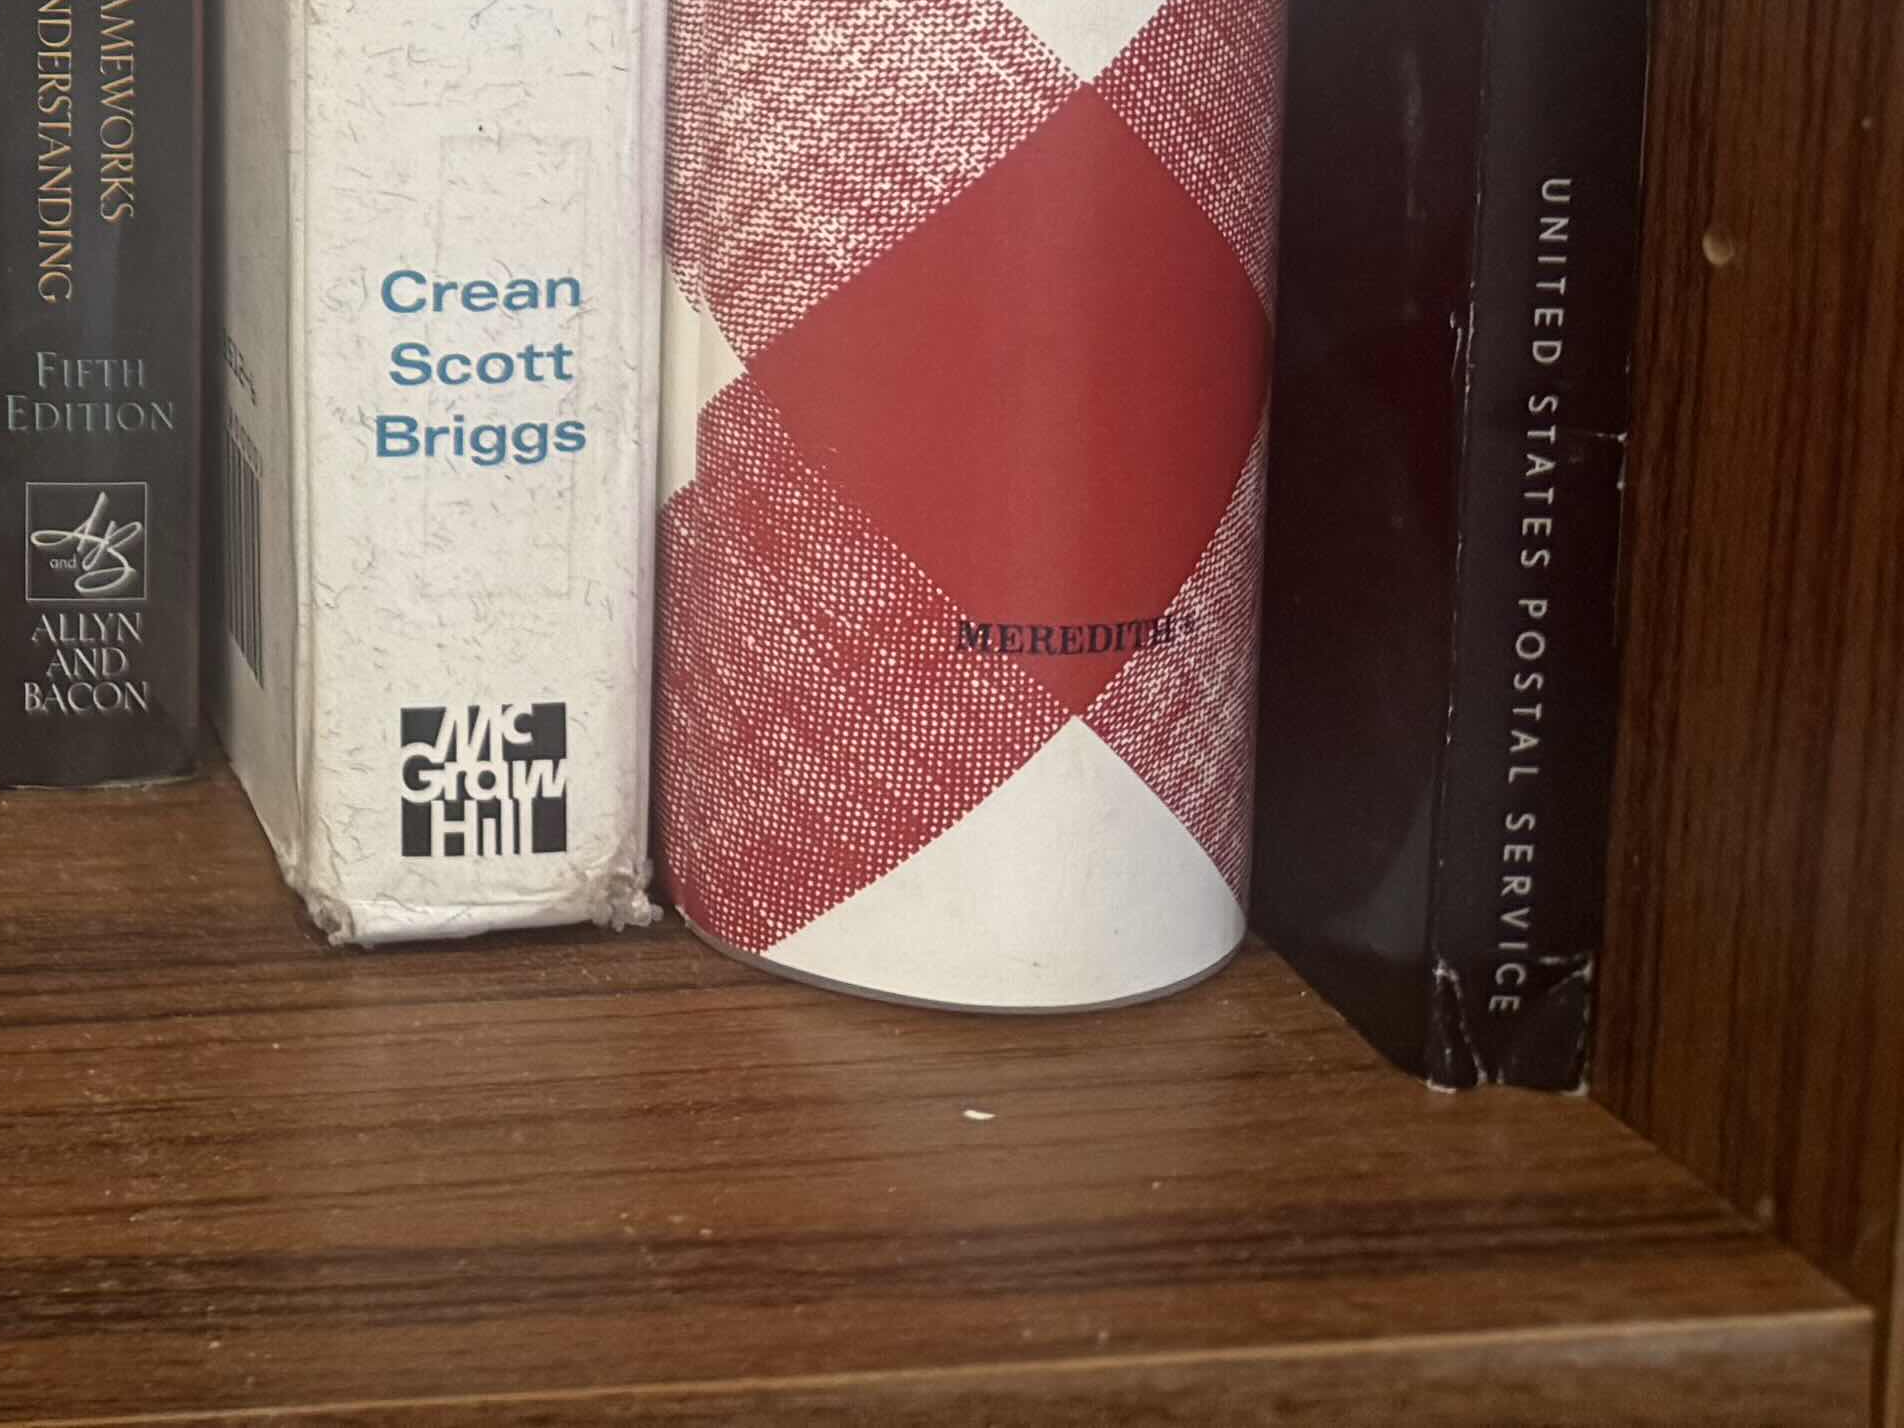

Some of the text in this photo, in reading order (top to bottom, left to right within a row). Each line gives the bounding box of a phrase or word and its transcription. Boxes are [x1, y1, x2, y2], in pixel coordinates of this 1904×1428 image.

[378, 267, 584, 318] Crean
[33, 350, 147, 395] FIFTH
[388, 340, 576, 388] Scott
[5, 391, 175, 435] EDITION
[373, 414, 590, 467] Briggs
[1489, 176, 1573, 1016] UNITED STATES POSTAL SERVICE
[30, 611, 143, 644] ALLYN
[958, 615, 1173, 655] MEREDITH
[45, 647, 129, 678] AND
[23, 679, 148, 714] BACON
[400, 741, 568, 804] Graw
[430, 798, 534, 856] Hill
